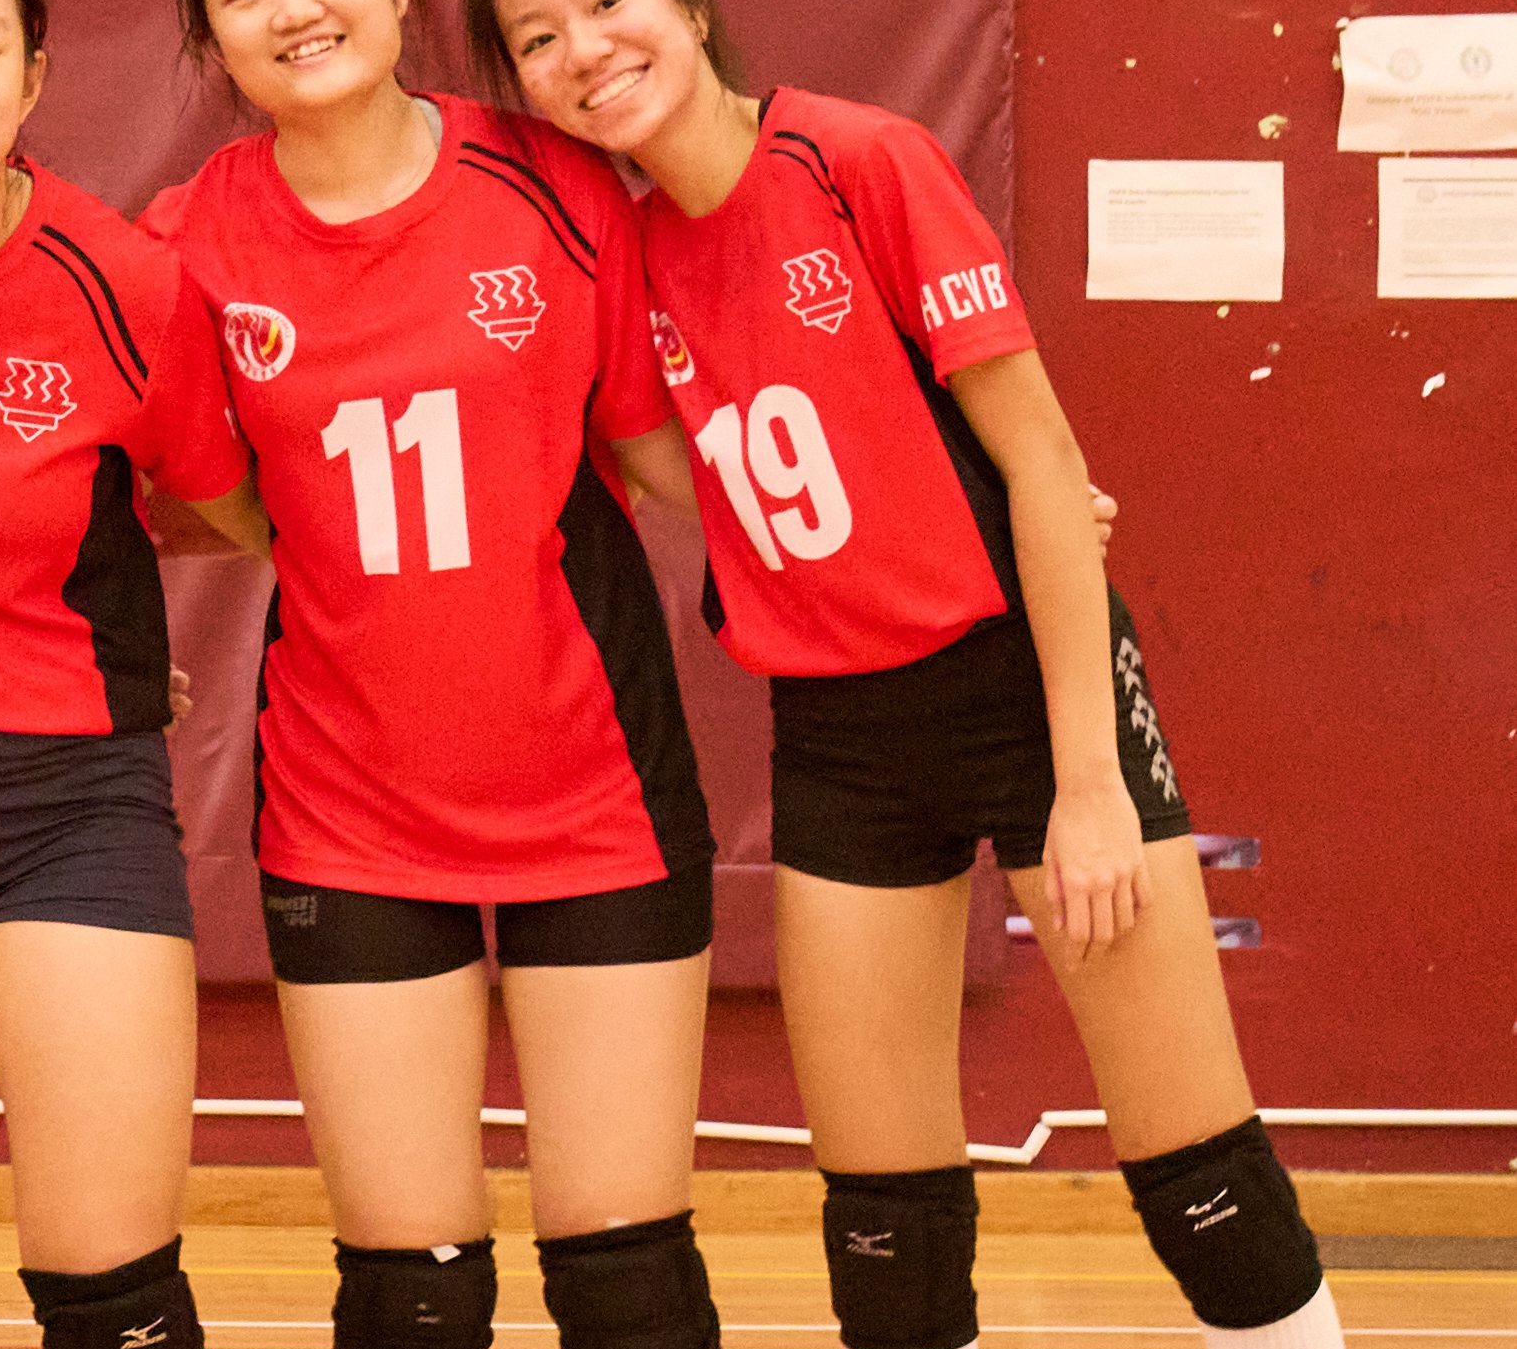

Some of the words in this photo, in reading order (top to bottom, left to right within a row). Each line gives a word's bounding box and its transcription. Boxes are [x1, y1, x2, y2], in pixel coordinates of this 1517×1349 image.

[920, 263, 1007, 332] HCVB
[321, 389, 470, 574] 11
[696, 385, 851, 569] 19
